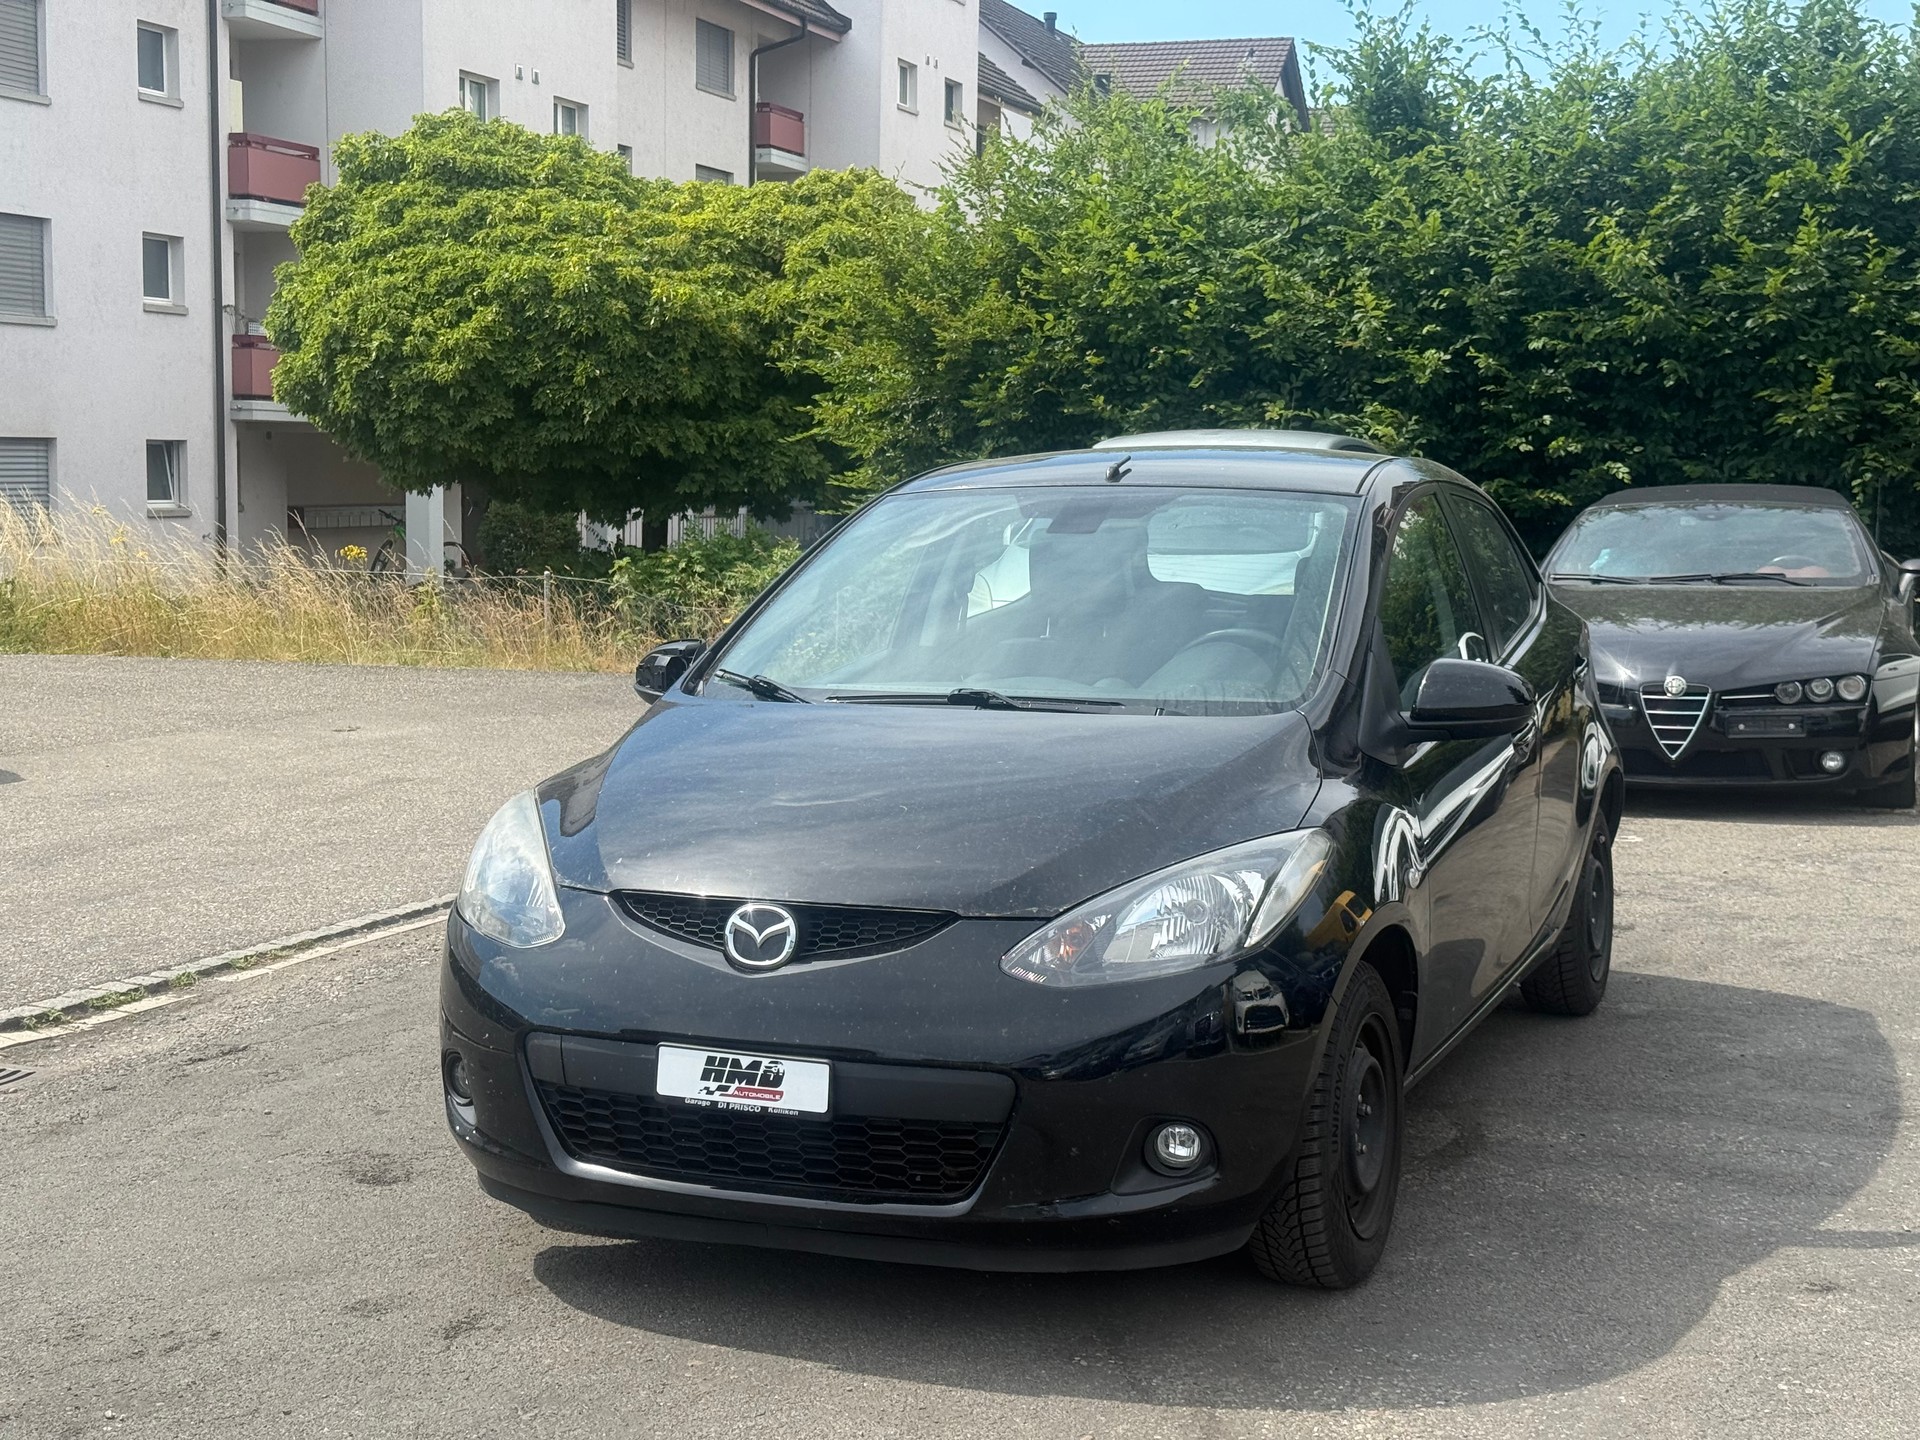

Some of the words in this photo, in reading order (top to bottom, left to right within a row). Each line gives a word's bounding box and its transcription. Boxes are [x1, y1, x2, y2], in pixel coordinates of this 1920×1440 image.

[733, 1090, 782, 1100] AUTOMOBILE
[684, 1097, 711, 1107] Garage
[717, 1101, 728, 1109] DI
[729, 1102, 762, 1113] PRISCO
[1331, 1053, 1347, 1154] UNIROYAL
